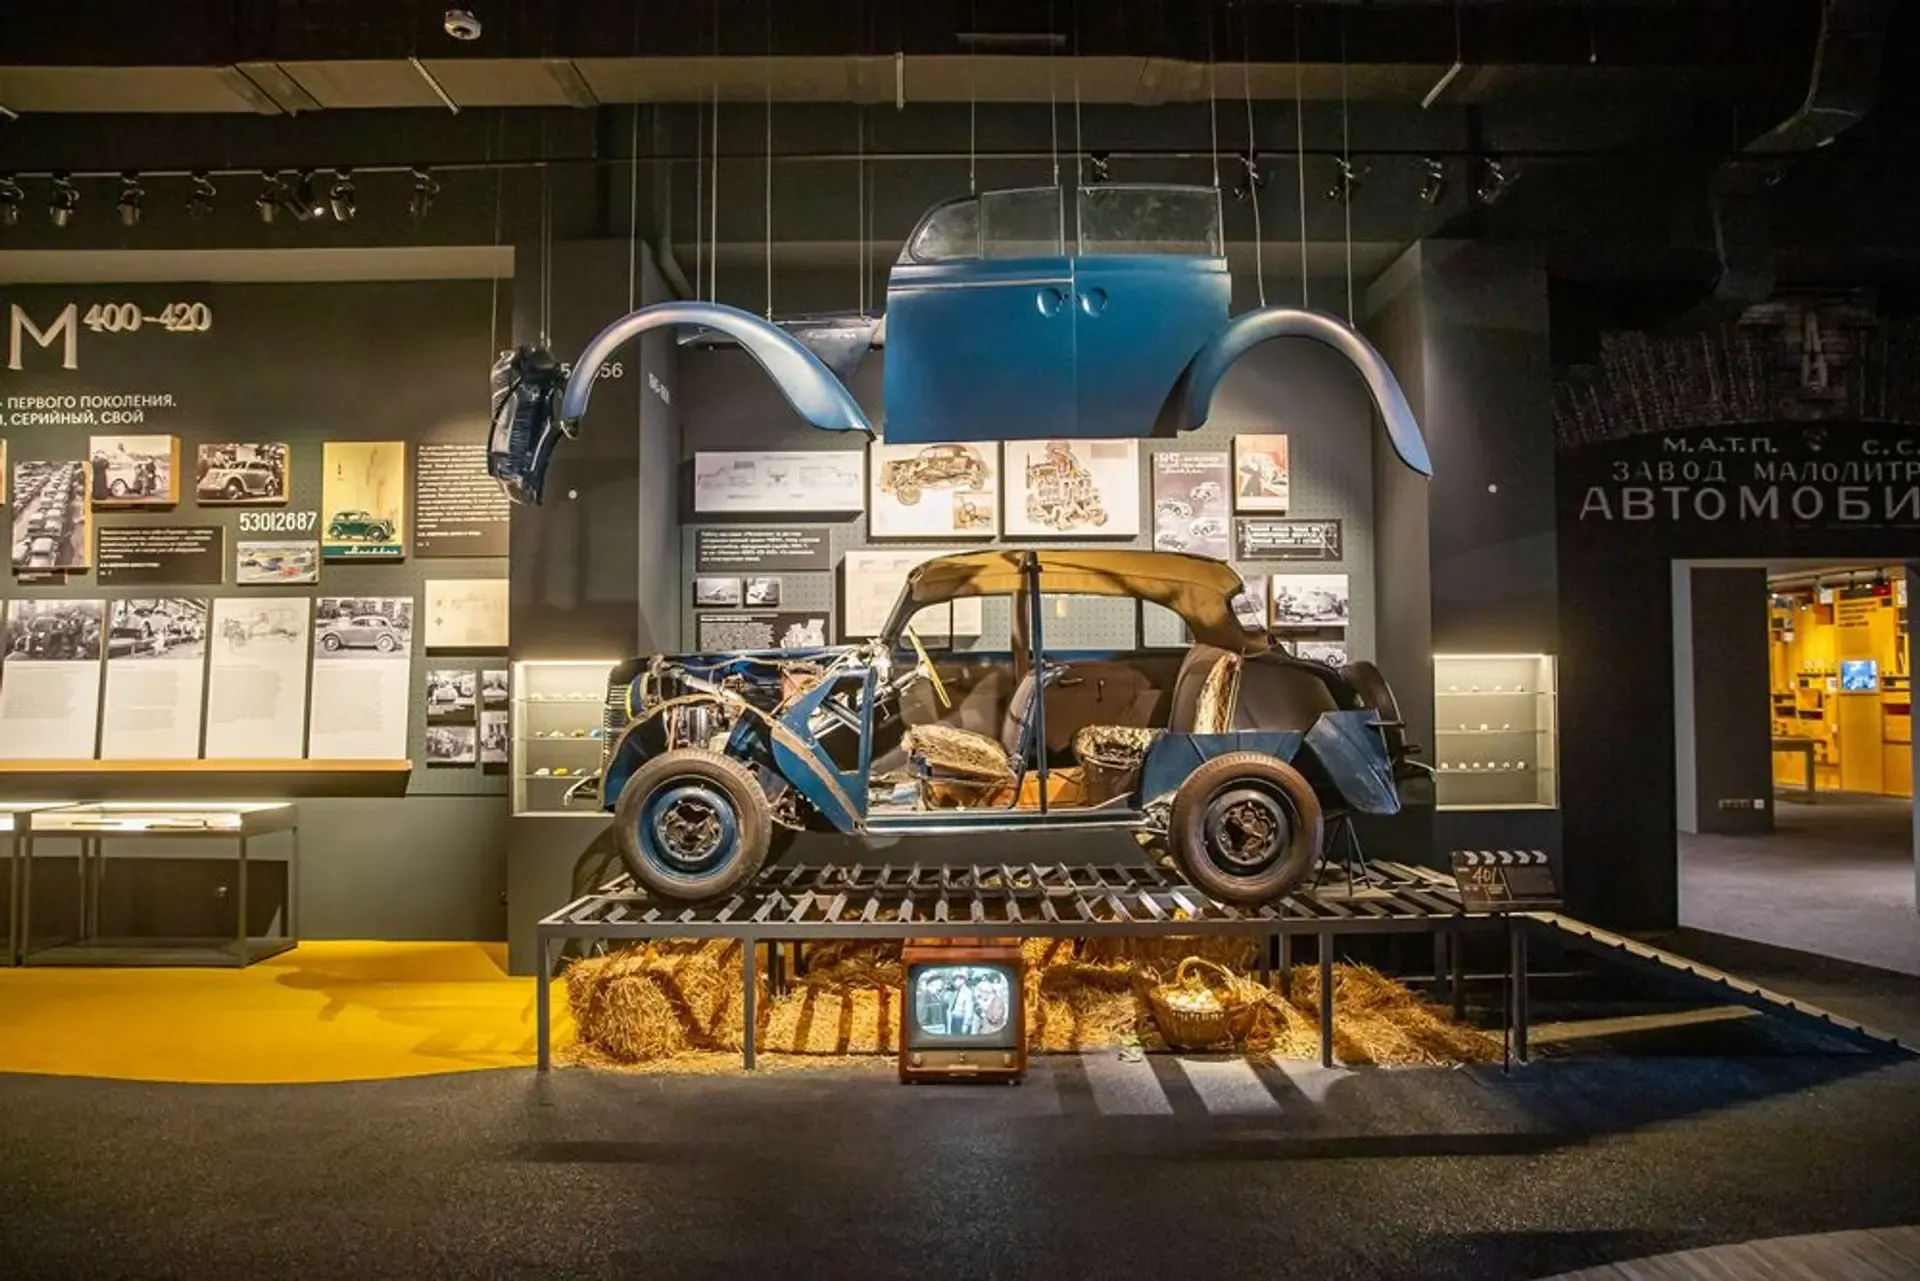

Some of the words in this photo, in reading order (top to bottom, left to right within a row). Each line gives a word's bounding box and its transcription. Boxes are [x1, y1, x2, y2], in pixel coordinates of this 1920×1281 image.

[7, 395, 76, 409] ПЕРВОГО
[80, 394, 177, 408] ПОКОЛЕНИЯ.
[11, 409, 99, 426] СЕРИЙНЫЙ,
[100, 409, 144, 424] СВОЙ
[1662, 437, 1779, 454] М.А.Т.П.
[1612, 460, 1728, 483] ЗАВОД
[1753, 460, 1920, 483] МАЛОЛИТР
[1579, 485, 1920, 521] АВТОМОБИ
